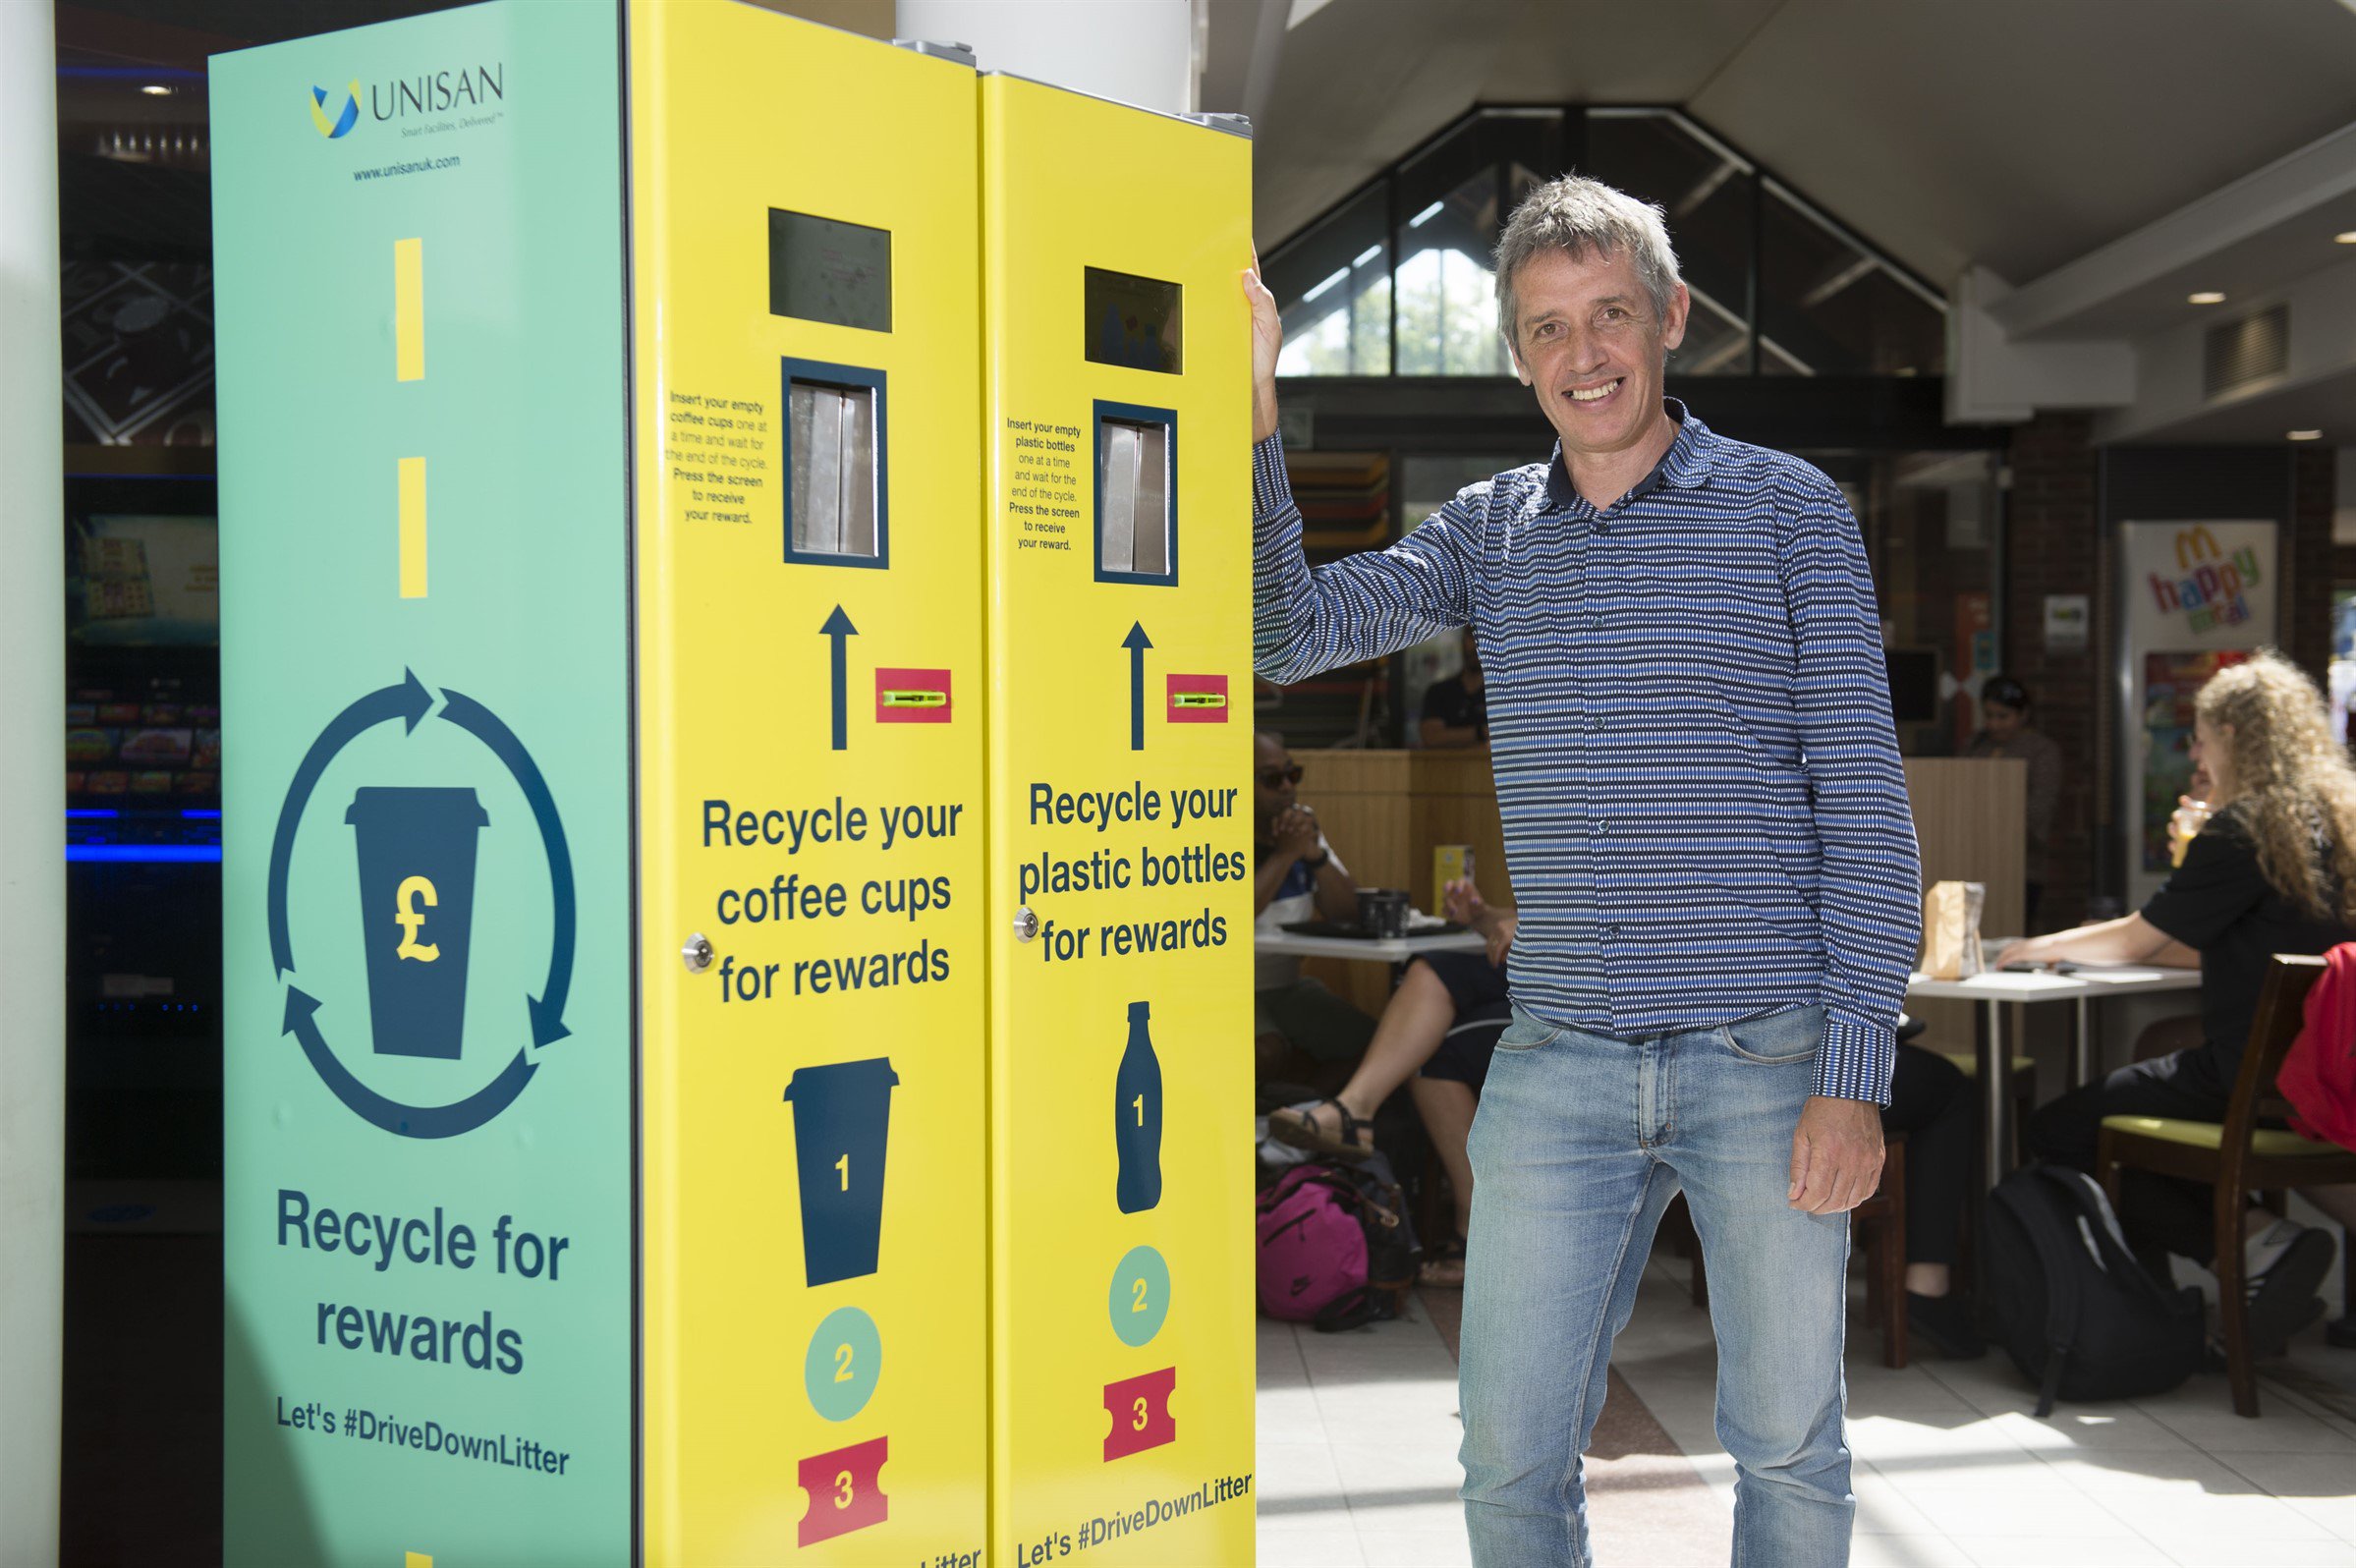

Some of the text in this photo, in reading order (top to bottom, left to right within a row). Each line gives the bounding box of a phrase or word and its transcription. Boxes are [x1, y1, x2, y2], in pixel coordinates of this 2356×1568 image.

[371, 62, 503, 121] UNISAN
[353, 154, 461, 181] www.unisanuk.com
[670, 391, 764, 416] Insert your empty
[670, 412, 767, 432] coffee cups one at
[1007, 418, 1081, 438] Insert your empty
[671, 430, 764, 450] a time and wait for
[1016, 436, 1075, 452] plastic bottles
[665, 450, 767, 471] the end of the cycle.
[674, 467, 763, 487] Press the screen
[1019, 454, 1034, 464] one
[1037, 456, 1043, 466] at
[1053, 456, 1070, 469] time
[1012, 486, 1077, 502] end of the cycle.
[1015, 471, 1076, 485] and wait for the
[693, 490, 745, 504] to receive
[1009, 502, 1080, 518] Press the screen
[685, 510, 752, 524] your reward.
[1024, 521, 1065, 533] to receive
[1018, 537, 1071, 550] your reward.
[2148, 545, 2259, 613] happy
[1030, 781, 1238, 831] Recycle your
[702, 797, 963, 855] Recycle your
[1019, 844, 1246, 905] plastic bottles
[717, 874, 951, 925] coffee cups
[1041, 908, 1228, 962] for rewards
[719, 939, 950, 1003] for rewards
[1133, 1093, 1145, 1127] 1
[835, 1153, 849, 1192] 1
[278, 1189, 569, 1281] Recycle for
[1132, 1278, 1148, 1313] 2
[317, 1303, 524, 1375] rewards
[834, 1343, 854, 1383] 2
[1132, 1397, 1148, 1430] 3
[277, 1396, 570, 1476] Let's #DriveDownLitter
[834, 1470, 853, 1510] 3
[1018, 1474, 1253, 1568] Let's #DriveDownLitter
